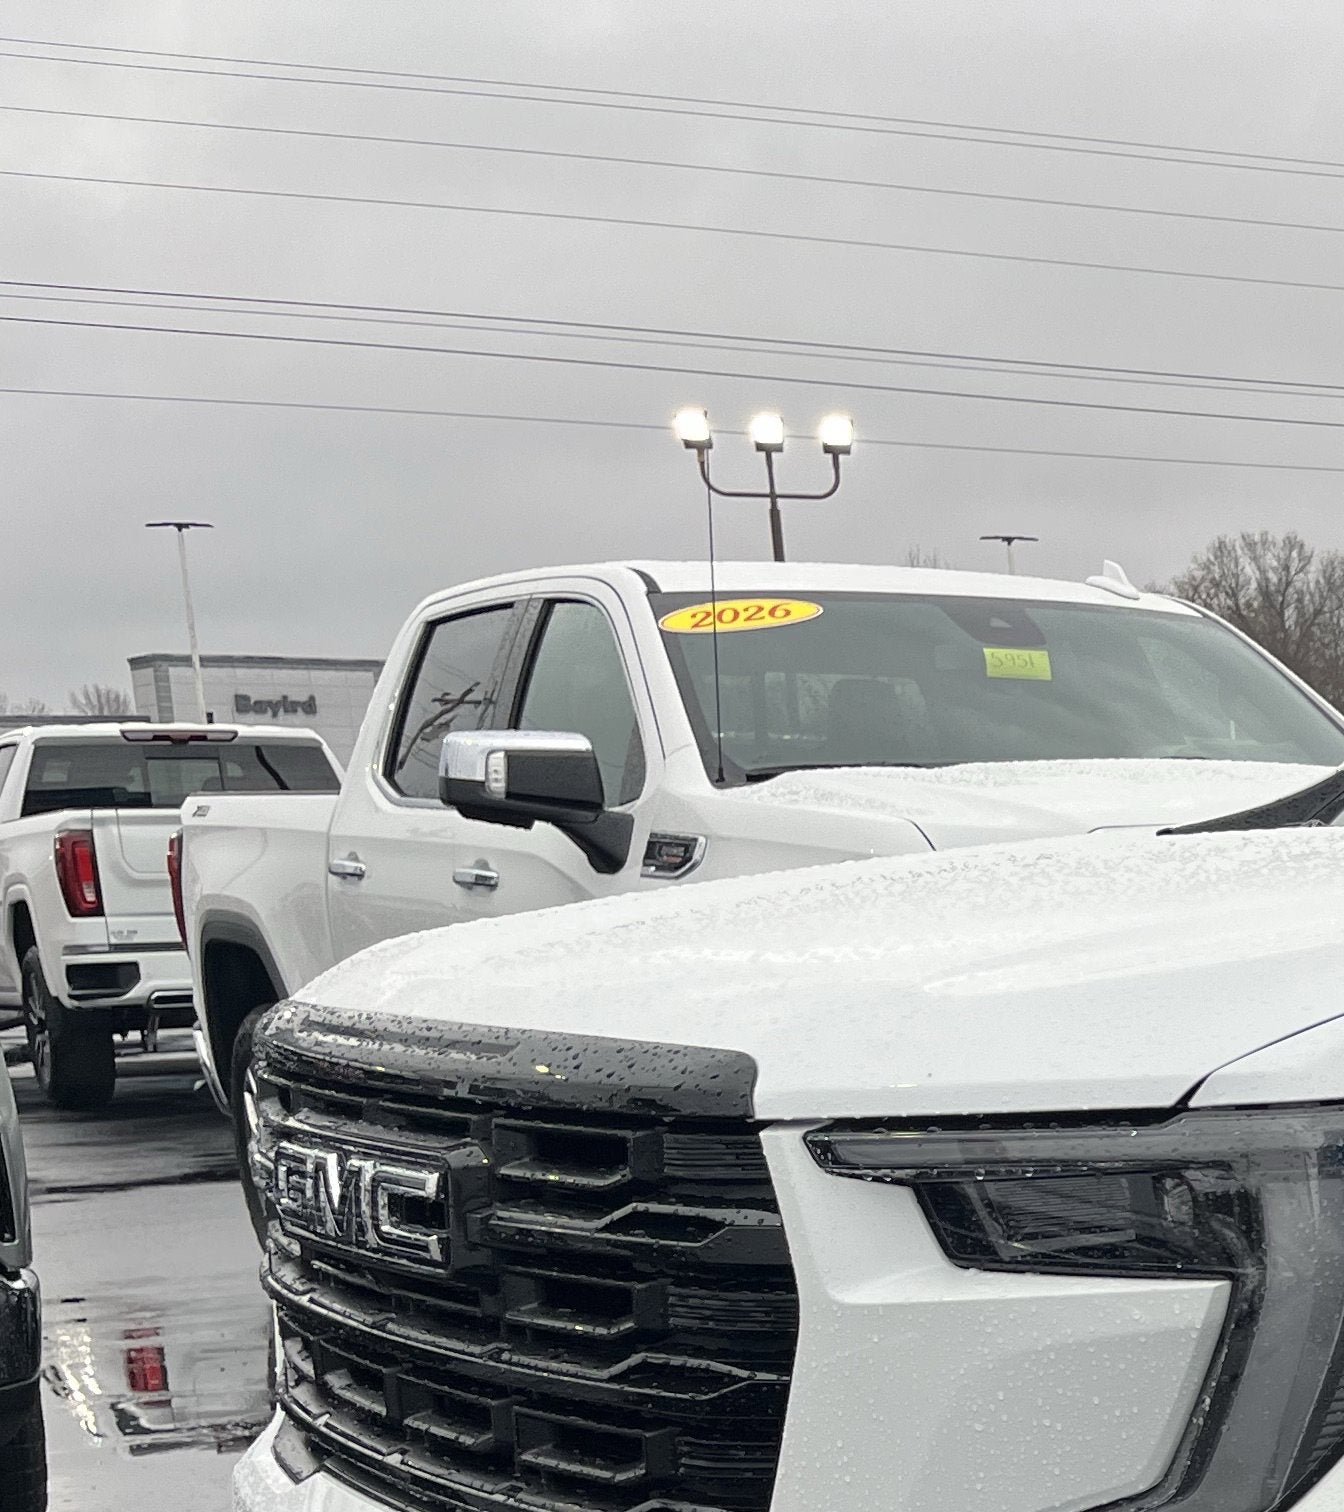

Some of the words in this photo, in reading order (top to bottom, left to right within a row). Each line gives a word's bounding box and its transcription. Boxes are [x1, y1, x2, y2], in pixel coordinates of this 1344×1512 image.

[690, 602, 792, 630] 2026
[990, 652, 1034, 669] 5951
[273, 1141, 443, 1263] GMC
